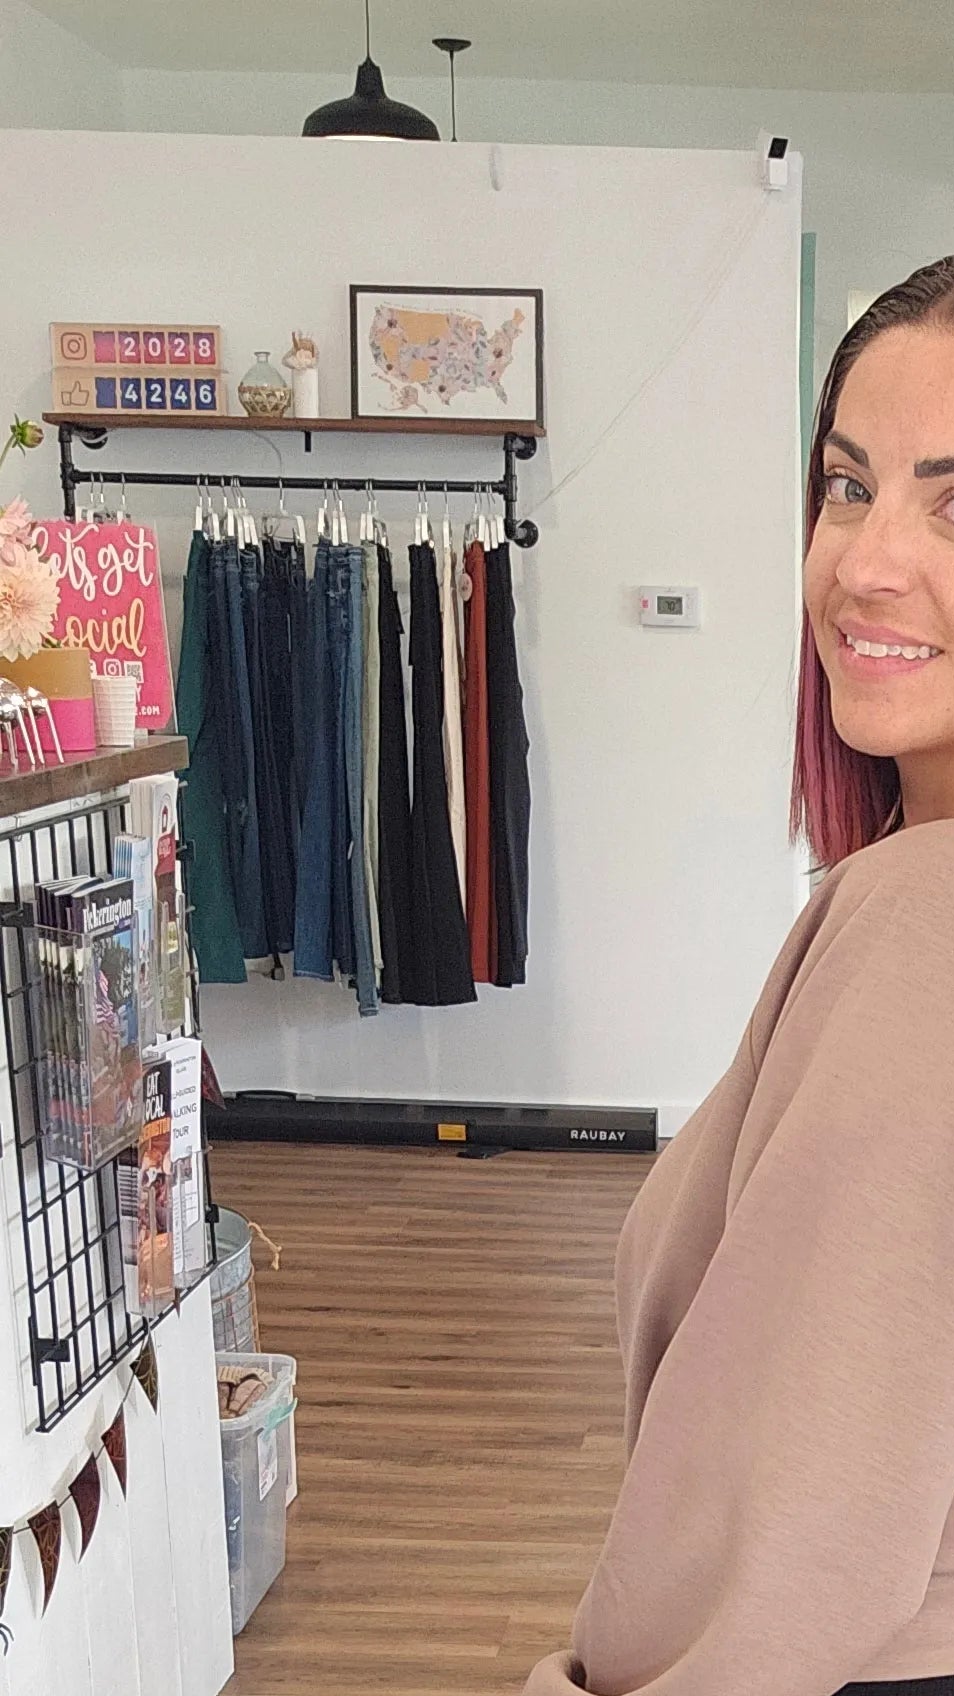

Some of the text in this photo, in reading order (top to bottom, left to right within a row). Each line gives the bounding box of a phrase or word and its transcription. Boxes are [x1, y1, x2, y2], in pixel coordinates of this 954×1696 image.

[124, 337, 211, 357] 2028
[125, 384, 212, 403] 4246
[98, 528, 154, 597] get
[147, 1071, 160, 1098] EAT
[570, 1129, 626, 1142] RAUBAY
